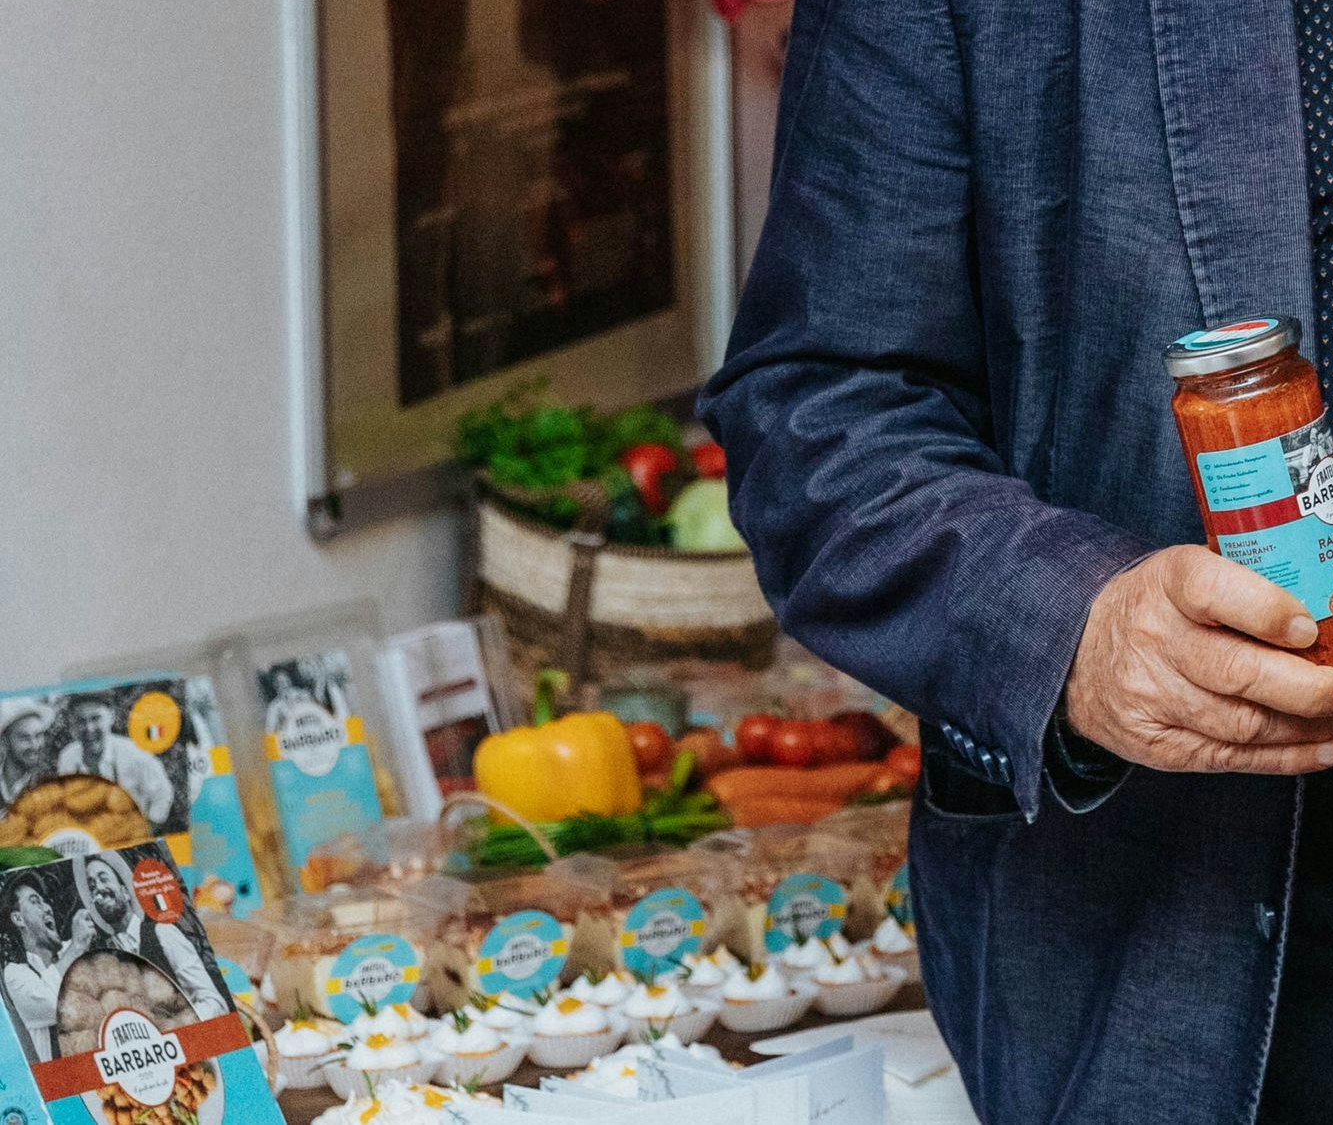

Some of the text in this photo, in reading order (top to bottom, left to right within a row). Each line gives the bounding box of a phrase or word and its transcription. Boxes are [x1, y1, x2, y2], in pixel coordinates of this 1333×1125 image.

[1224, 539, 1258, 549] PREMIUM
[1226, 545, 1277, 558] RESTAURANT-
[112, 1022, 150, 1049] FRATELLI
[101, 1040, 177, 1078] BARBARO
